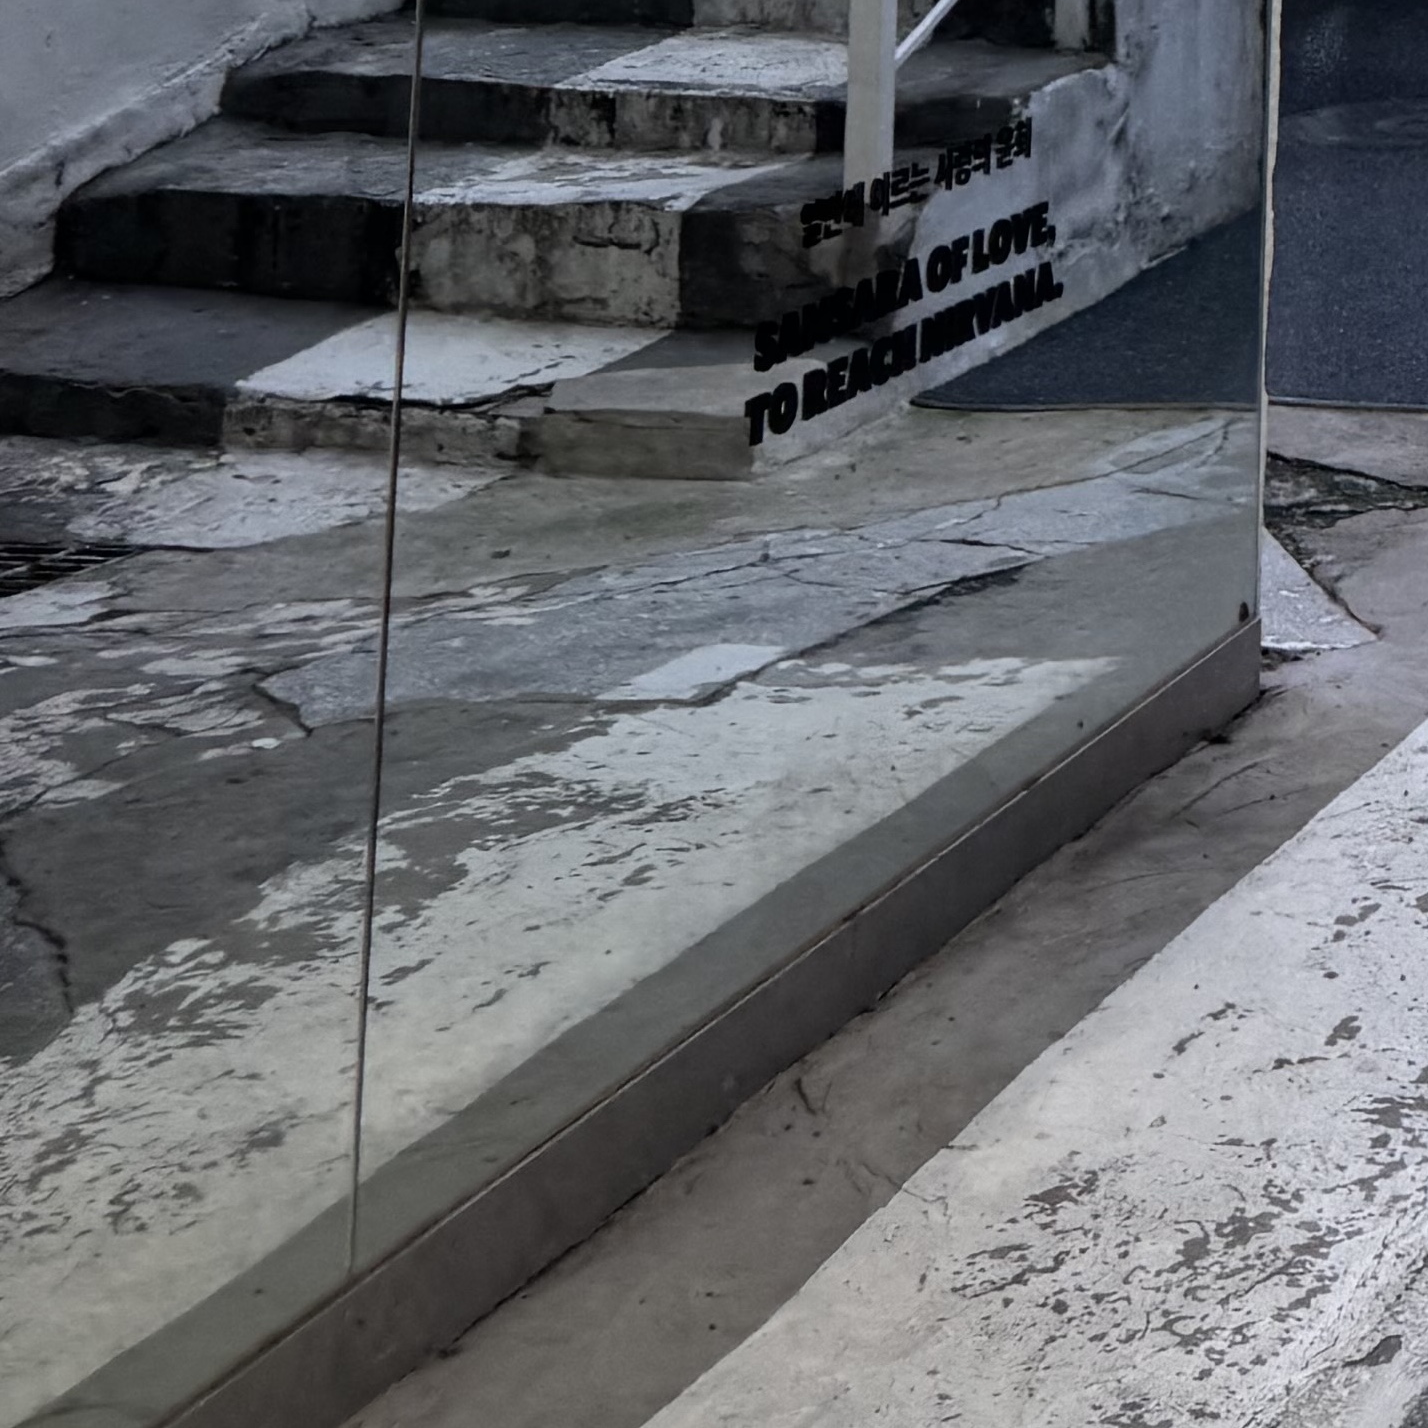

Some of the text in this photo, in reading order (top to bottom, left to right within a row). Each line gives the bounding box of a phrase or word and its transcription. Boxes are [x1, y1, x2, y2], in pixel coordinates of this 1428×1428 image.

[926, 236, 972, 293] OF
[972, 201, 1056, 274] LOVE,
[744, 382, 798, 447] TO
[802, 323, 917, 421] REACH
